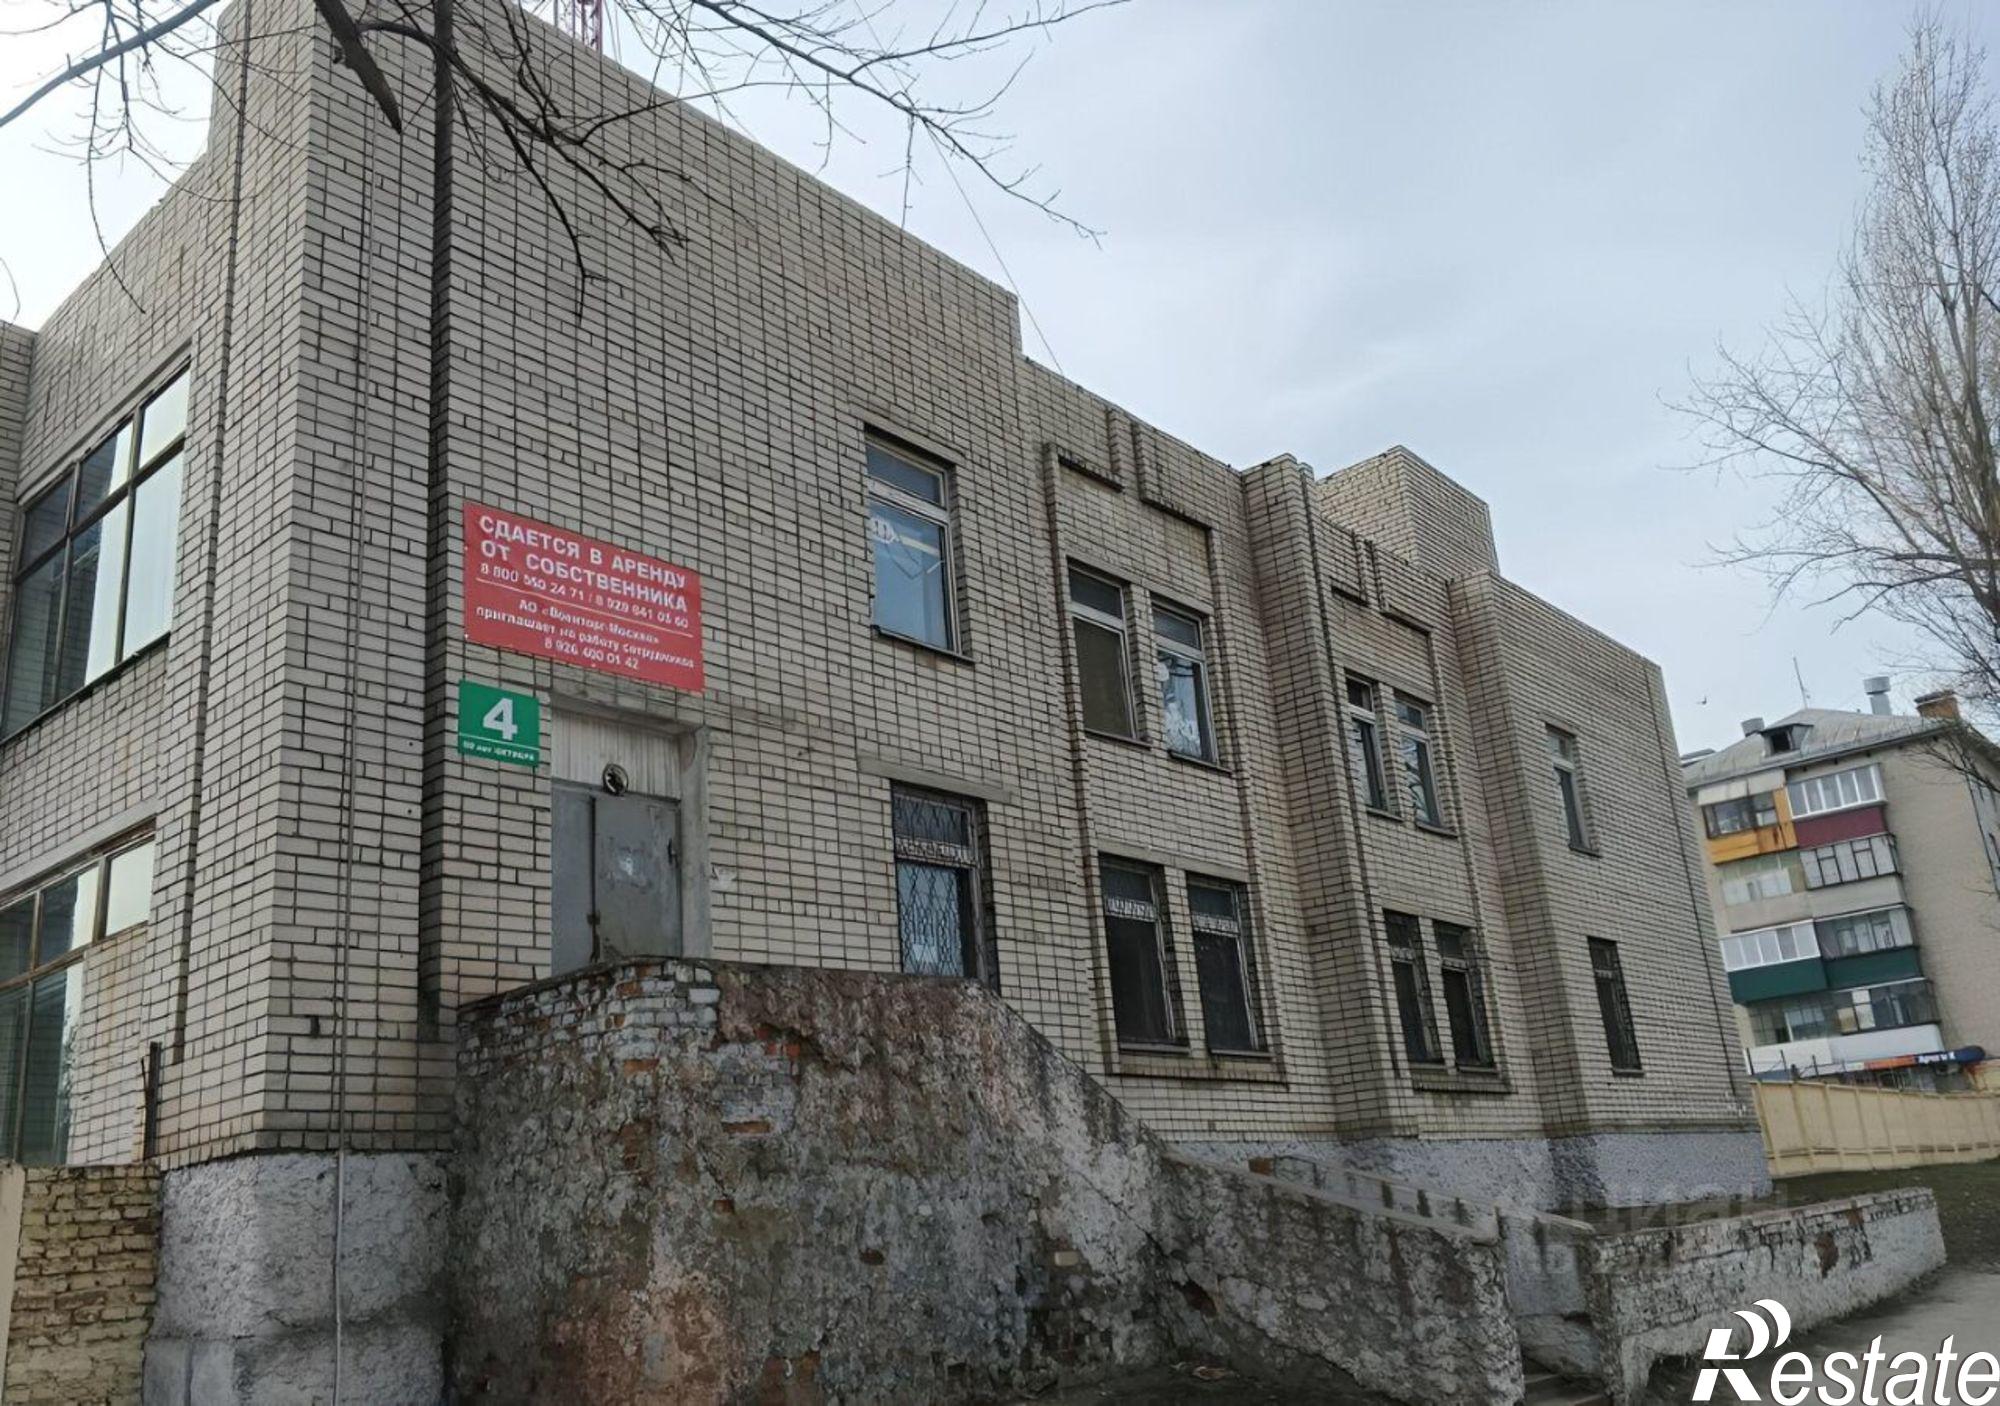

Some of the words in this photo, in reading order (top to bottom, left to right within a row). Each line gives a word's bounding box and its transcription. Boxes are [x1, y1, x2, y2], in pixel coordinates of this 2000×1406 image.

[479, 515, 580, 559] СДАЕТСЯ
[590, 547, 603, 565] В
[611, 555, 686, 589] АРЕНДУ
[480, 563, 489, 575] 8
[493, 566, 519, 582] 800
[550, 582, 566, 596] 24
[569, 587, 584, 601] 71
[481, 540, 511, 561] ОТ
[526, 553, 688, 612] СОБСТВЕННИКА
[519, 599, 537, 613] АО
[482, 697, 519, 741] 4
